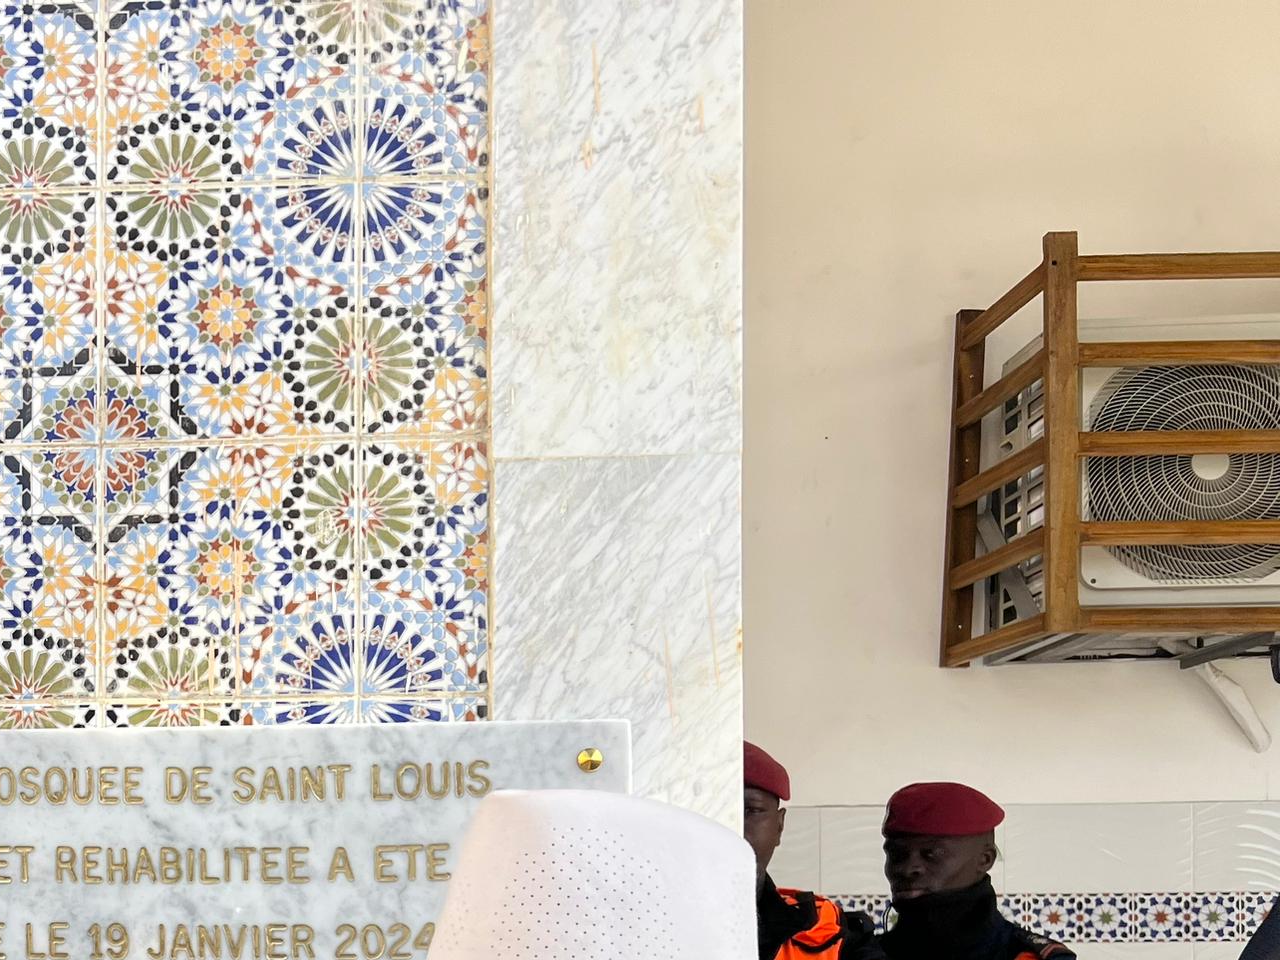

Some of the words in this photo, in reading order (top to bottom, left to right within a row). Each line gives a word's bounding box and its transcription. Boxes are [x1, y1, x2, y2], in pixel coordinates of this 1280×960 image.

[164, 766, 215, 804] DE
[232, 763, 352, 804] SAINT
[370, 760, 492, 801] LOUIS
[55, 845, 310, 885] REHABILITEE
[327, 846, 355, 883] A
[373, 843, 452, 882] ETE
[25, 921, 70, 960] LE
[87, 921, 130, 960] 19
[147, 922, 316, 960] JANVIER
[334, 921, 435, 960] 2024
